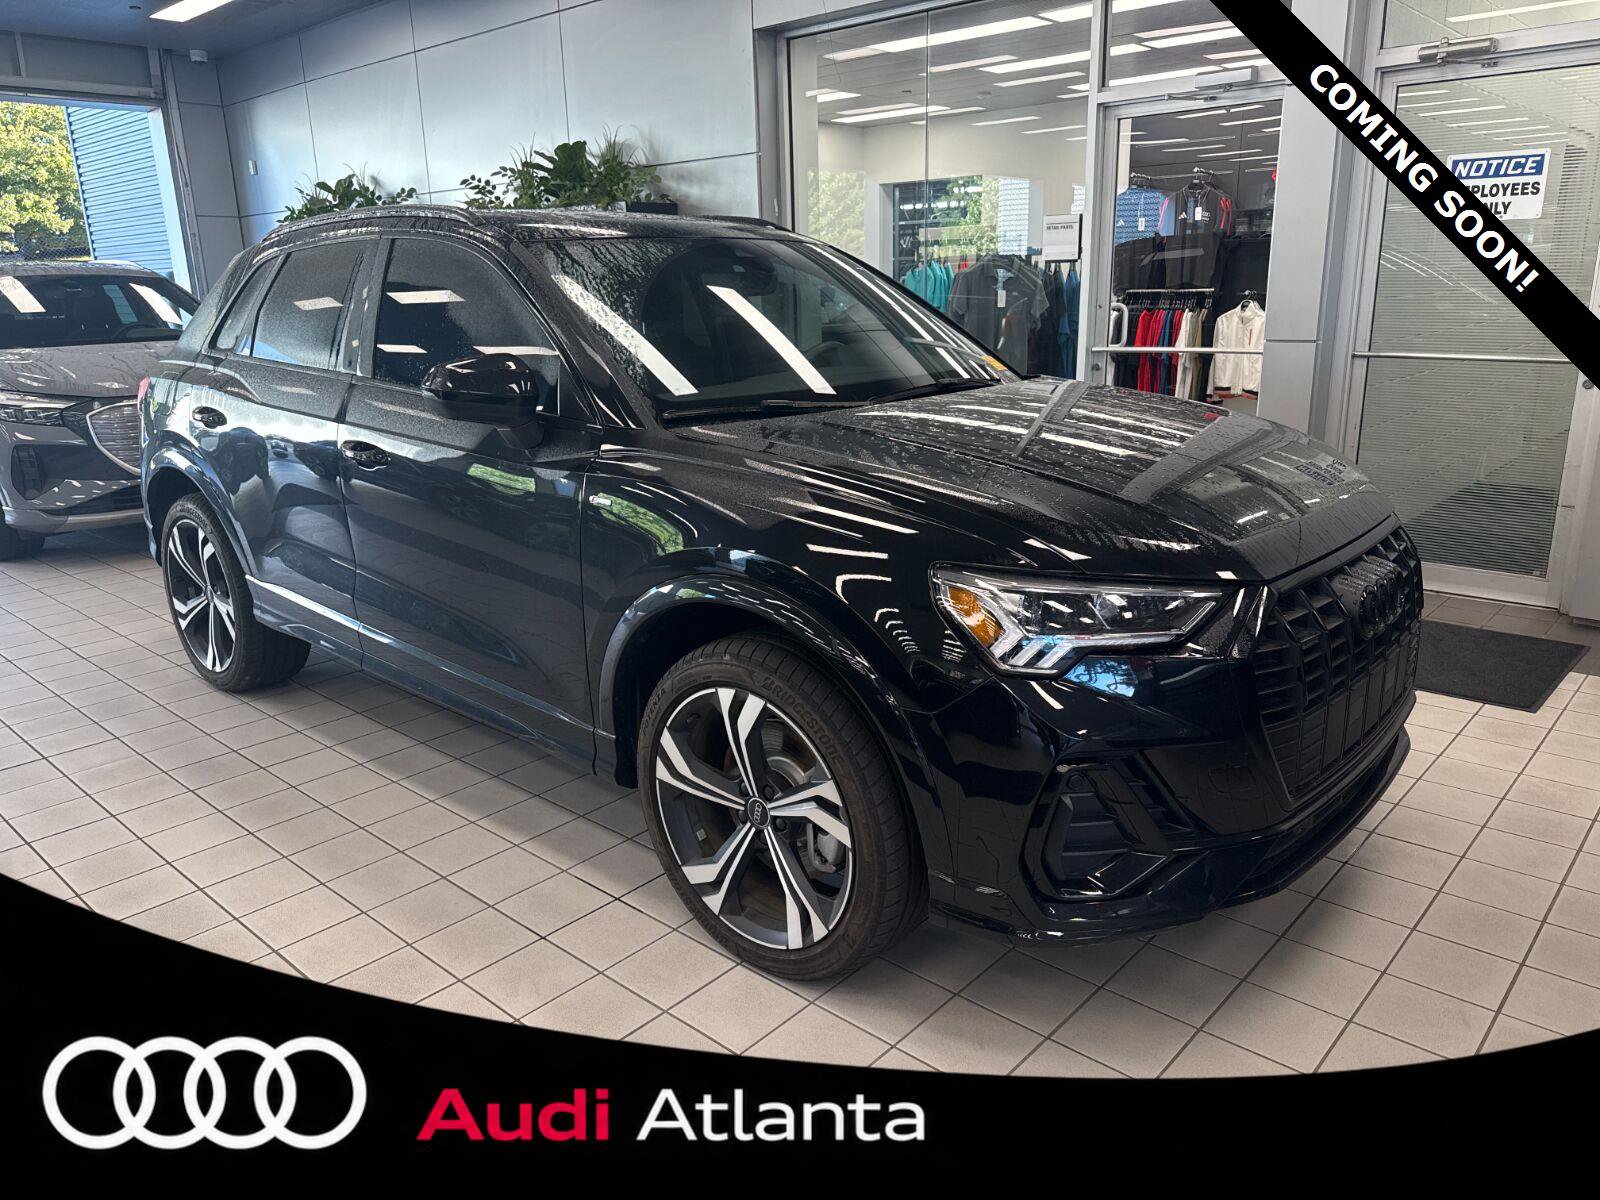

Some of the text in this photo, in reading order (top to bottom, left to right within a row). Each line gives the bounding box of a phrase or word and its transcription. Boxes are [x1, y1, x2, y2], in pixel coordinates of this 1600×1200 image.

[1454, 156, 1541, 178] NOTICE
[1465, 182, 1541, 198] PLOYEES
[761, 676, 844, 764] BRIDGESTONE
